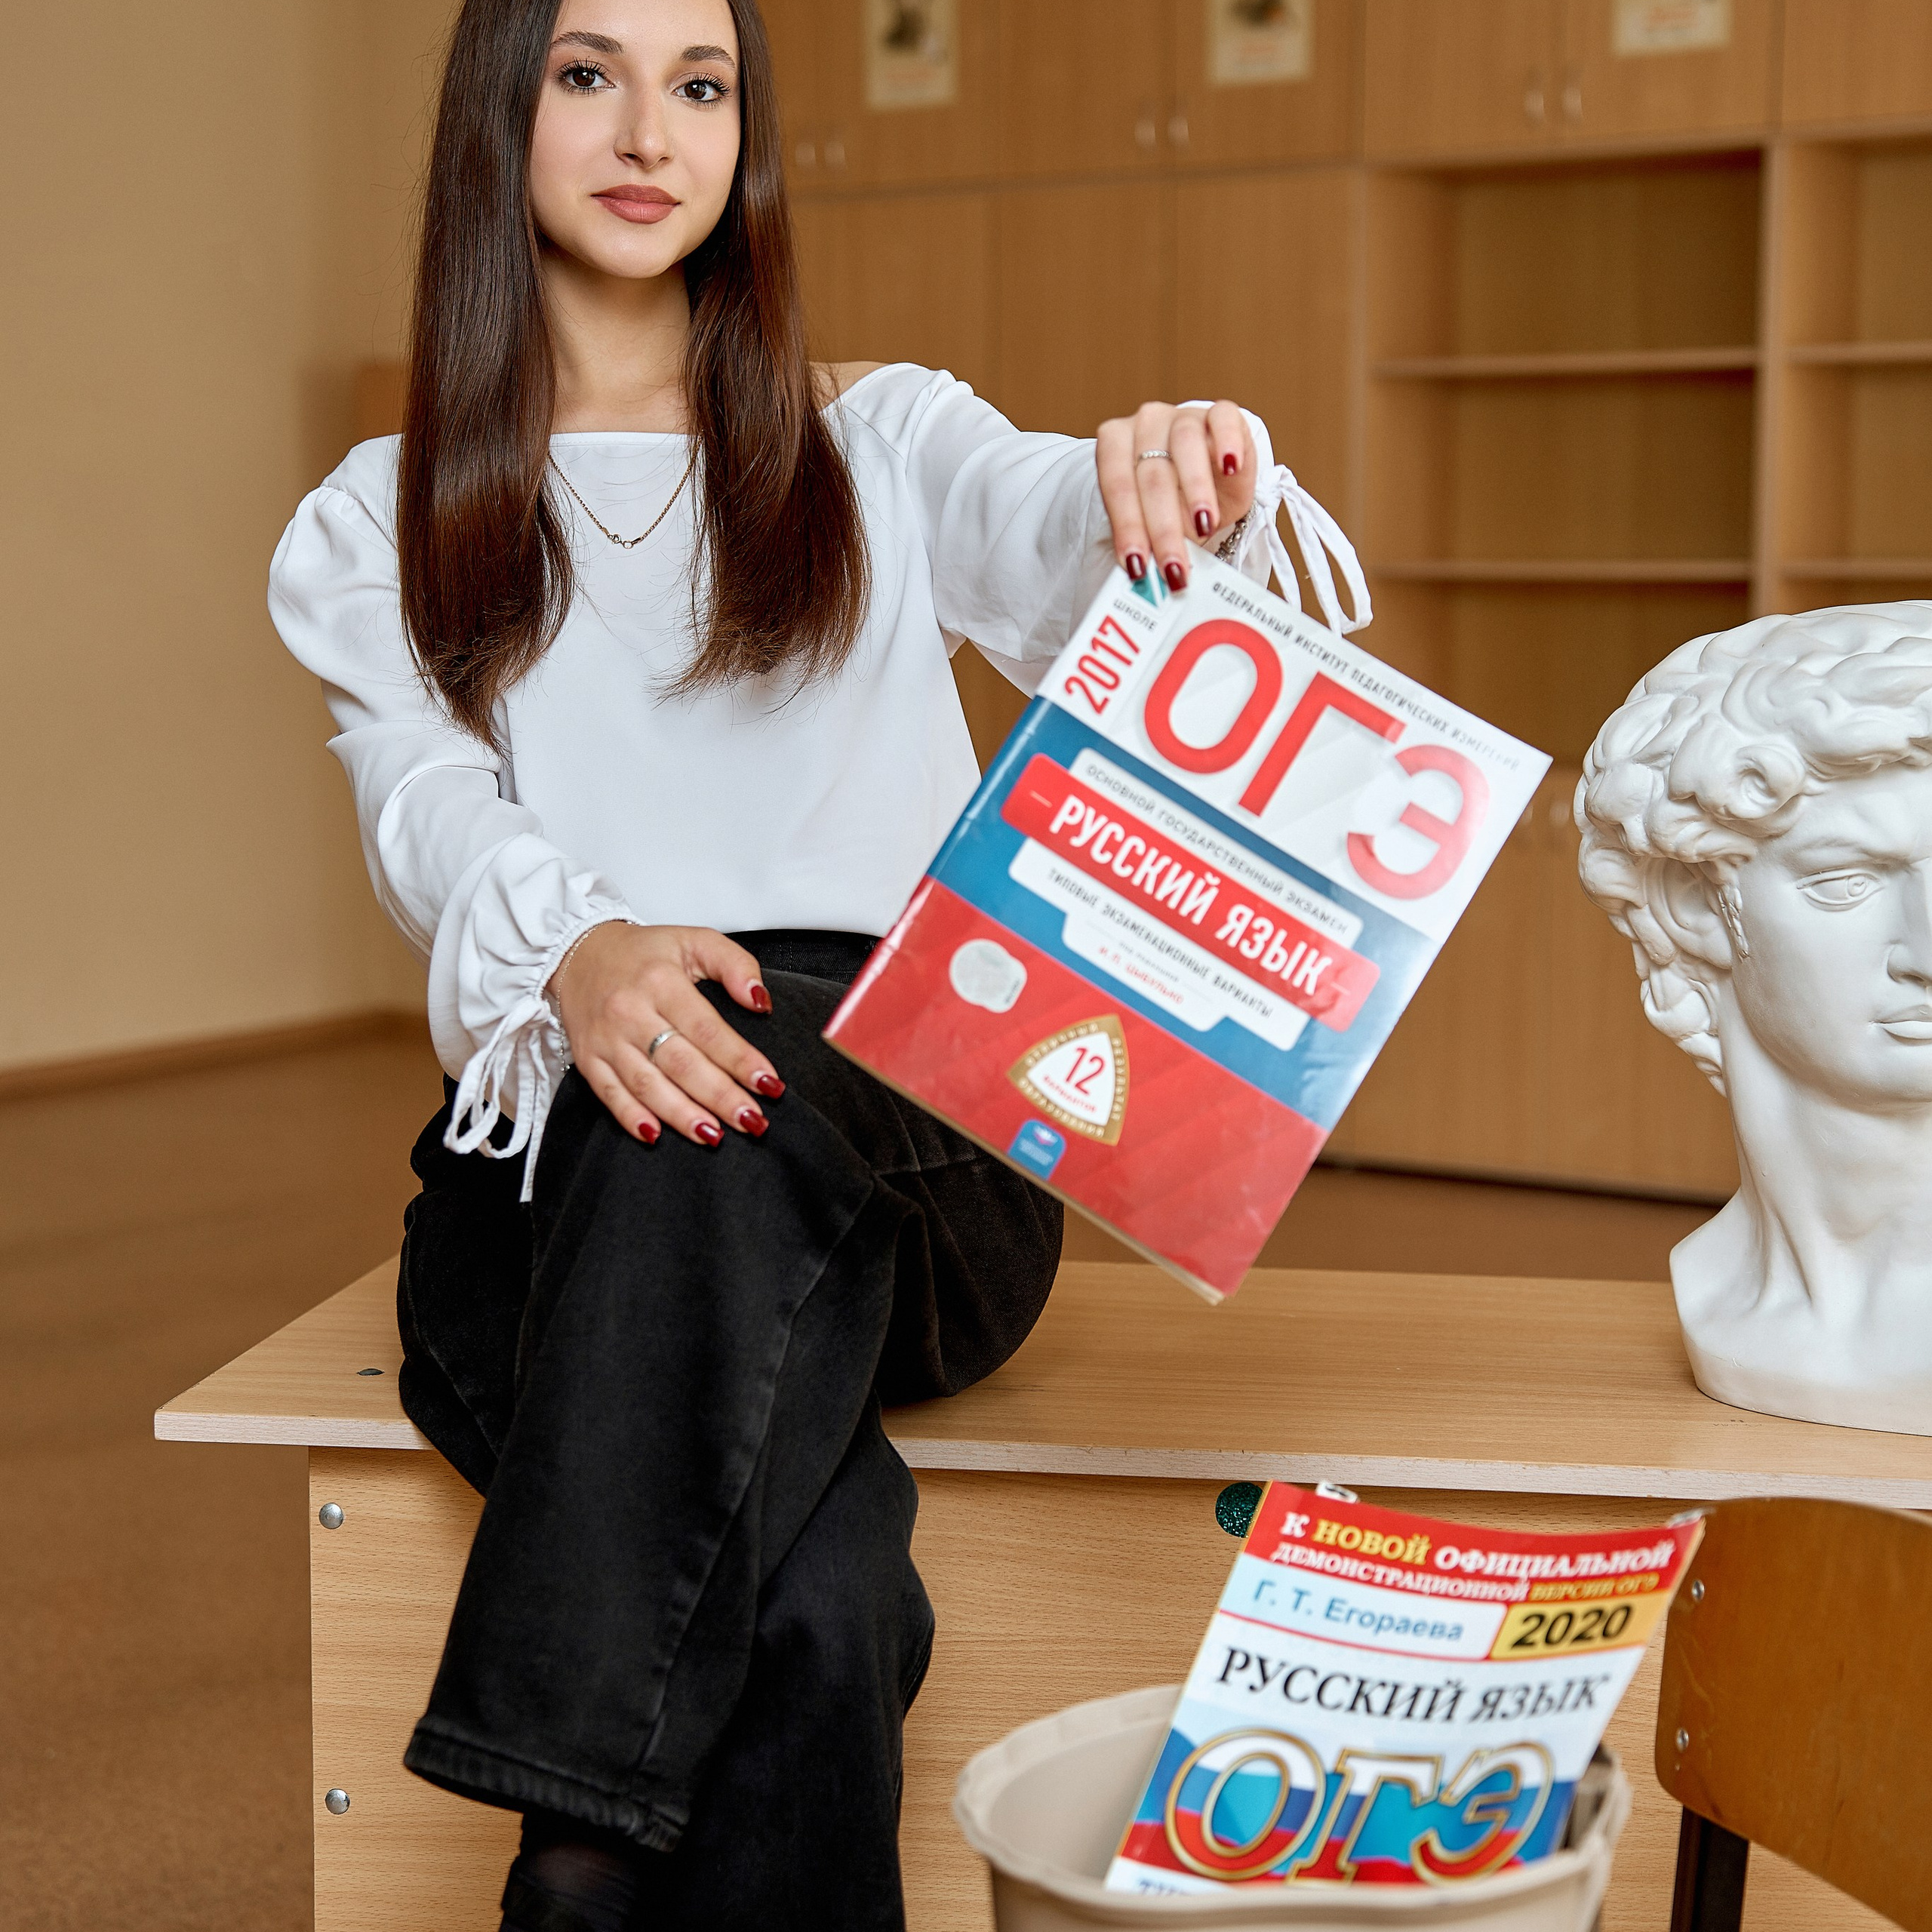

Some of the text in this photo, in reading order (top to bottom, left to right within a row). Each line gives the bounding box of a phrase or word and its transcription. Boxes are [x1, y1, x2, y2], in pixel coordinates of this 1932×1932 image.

[1113, 598, 1158, 632] ШКОЛЕ
[1212, 581, 1295, 638] ФЕДЕРАЛЬНЫЙ
[1294, 633, 1349, 674] ИНСТИТУТ
[1351, 668, 1449, 733] ПЕДАГОГИЧЕСКИХ
[1065, 615, 1140, 715] 2017
[1143, 618, 1491, 900] ОГЭ
[1086, 764, 1349, 935] ОСНОВНОЙ ГОСУДАРСТВЕННЫЙ ЭКЗАМЕН
[1049, 794, 1334, 995] РУССКИЙ ЯЗЫК
[1048, 868, 1100, 908] ТИПОВЫЕ
[1102, 903, 1211, 980] ЭКЗАМЕНАЦИОННЫЕ
[1212, 974, 1273, 1017] ВАРИАНТЫ
[1066, 1048, 1105, 1096] 12
[1270, 1543, 1530, 1601] ДЕМОНСТРАЦИОННОЙ
[1280, 1512, 1675, 1578] К НОВОЙ ОФИЦИАЛЬНОЙ
[1253, 1579, 1464, 1641] Г. Т. Егораева
[1511, 1603, 1632, 1650] 2020
[1217, 1646, 1611, 1724] РУССКИЙ ЯЗЫК
[1168, 1728, 1553, 1887] ОГЭ
